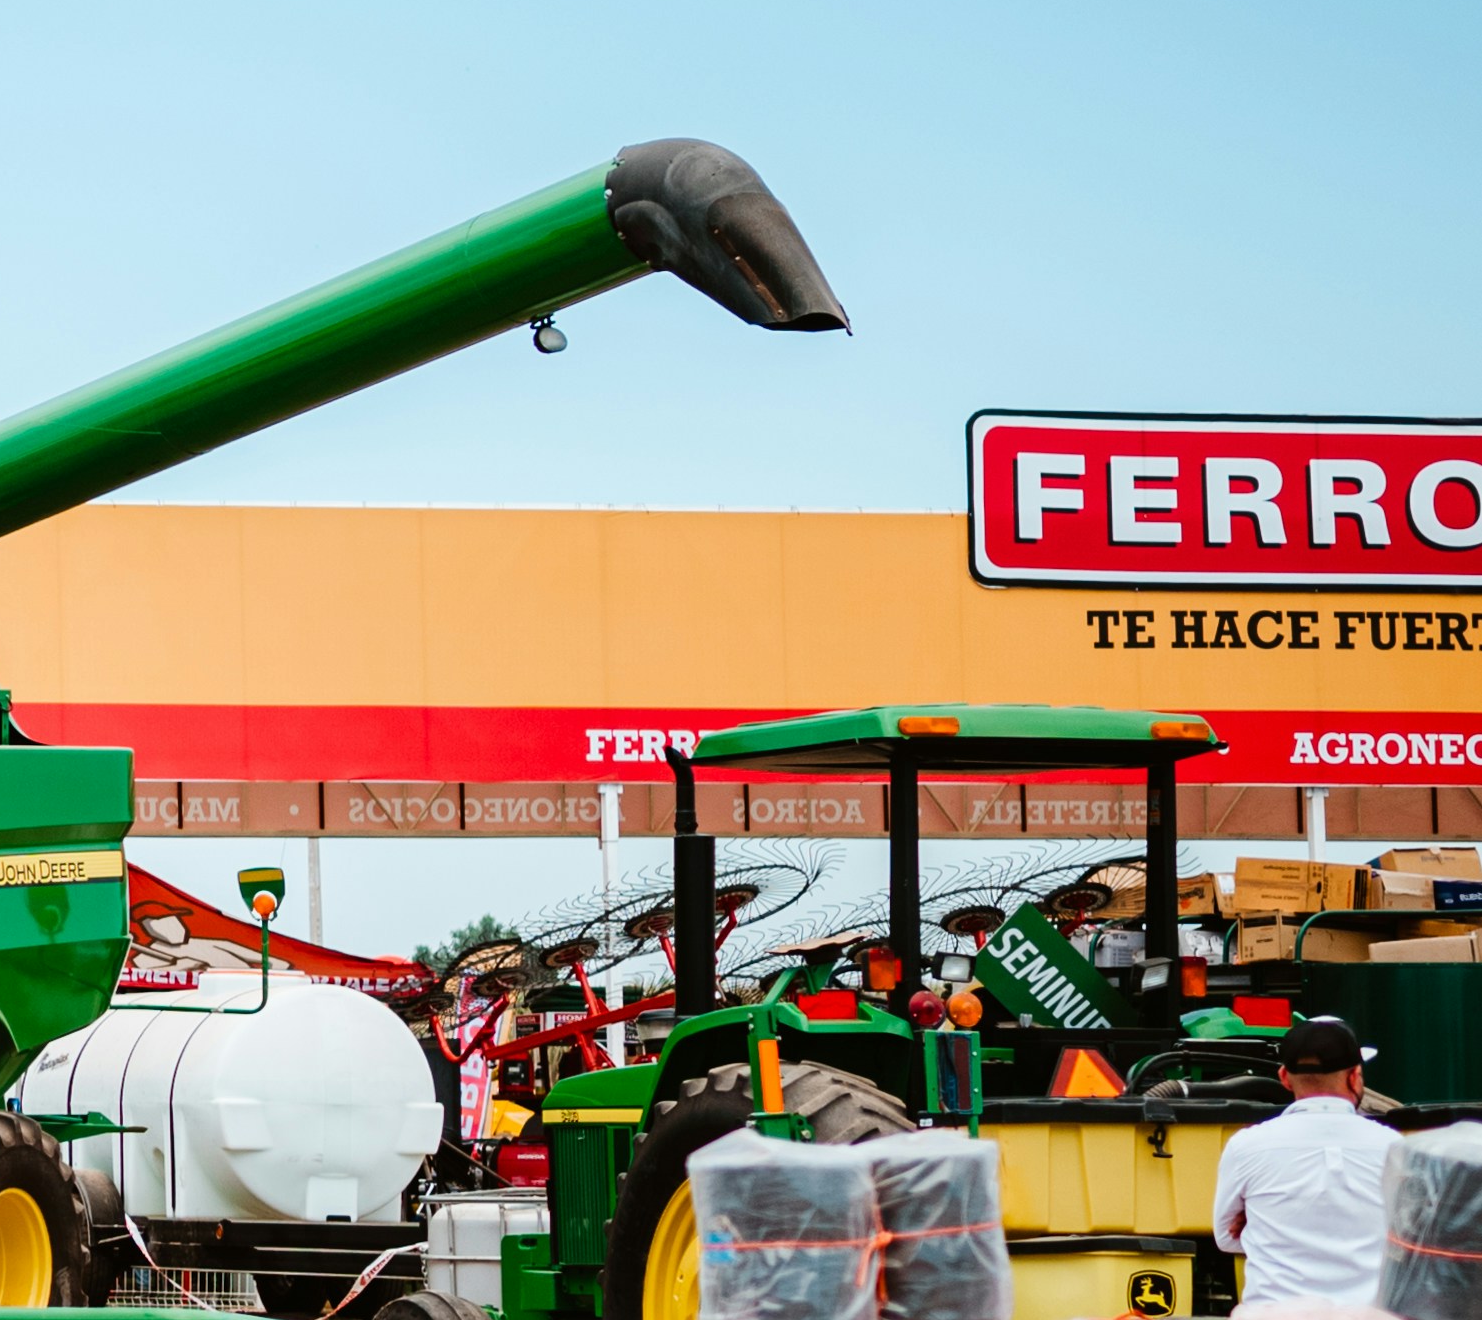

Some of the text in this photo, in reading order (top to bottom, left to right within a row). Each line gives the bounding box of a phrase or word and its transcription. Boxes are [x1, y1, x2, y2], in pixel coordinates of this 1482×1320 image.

[1087, 609, 1155, 649] TE
[1171, 609, 1320, 649] HACE
[585, 728, 716, 762] FERR
[39, 859, 86, 880] DEERE
